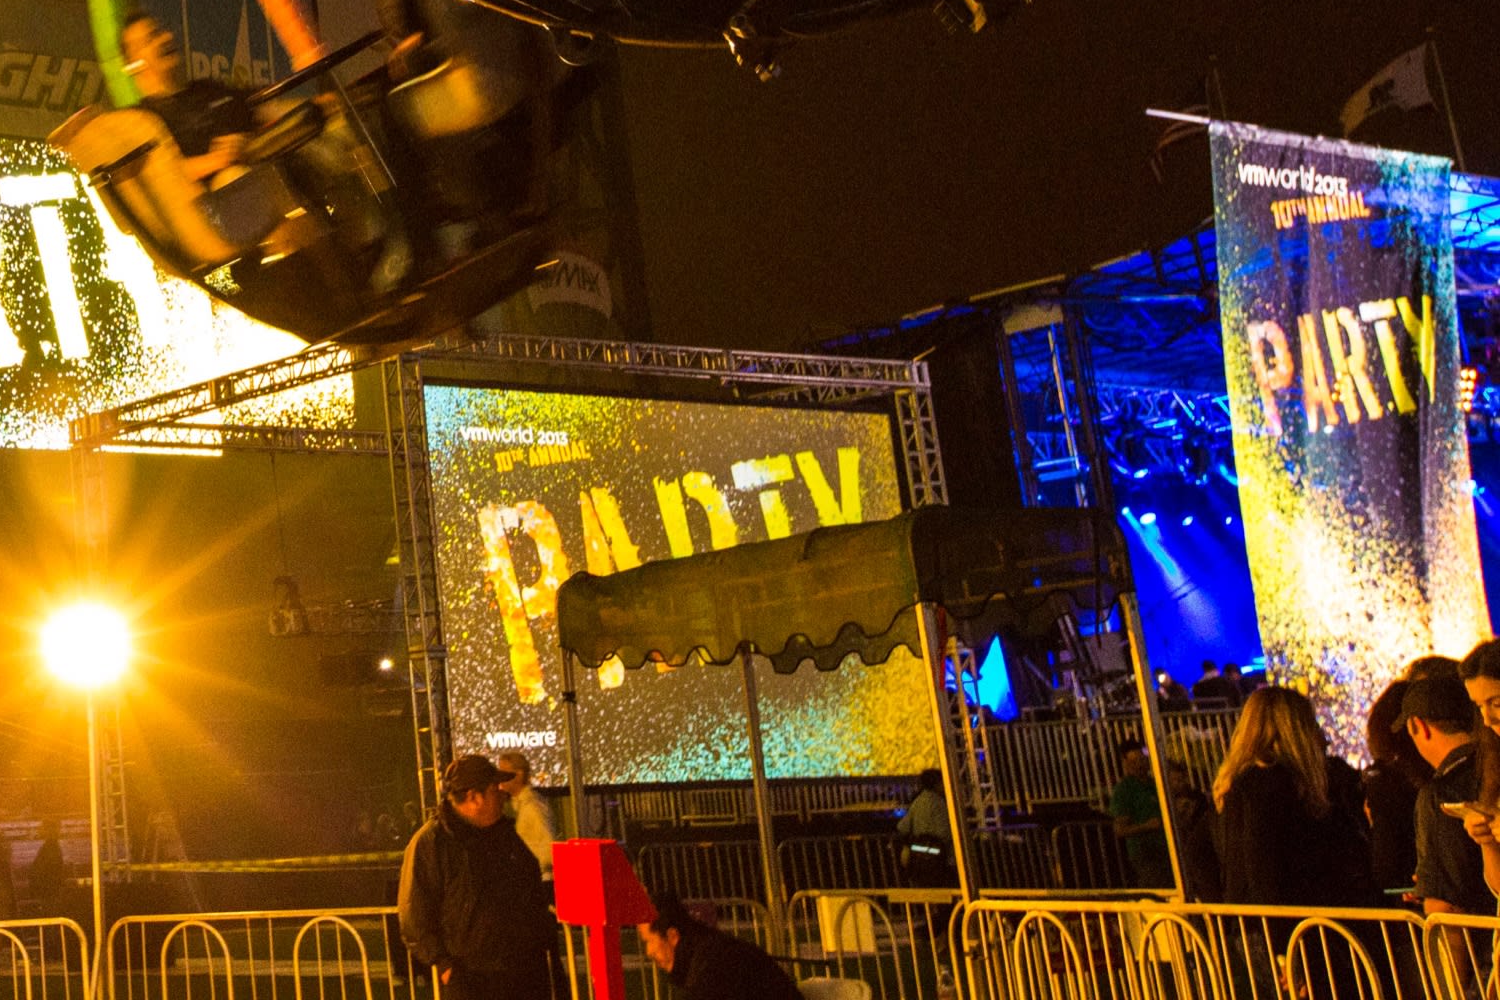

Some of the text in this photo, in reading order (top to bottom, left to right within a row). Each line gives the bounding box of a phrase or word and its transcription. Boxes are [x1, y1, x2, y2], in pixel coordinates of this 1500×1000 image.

[1238, 162, 1349, 197] vmworld 2013
[1270, 197, 1307, 230] 10TH
[1246, 294, 1437, 437] PARTY
[460, 424, 568, 447] vmworld 2013
[486, 729, 557, 749] vmware
